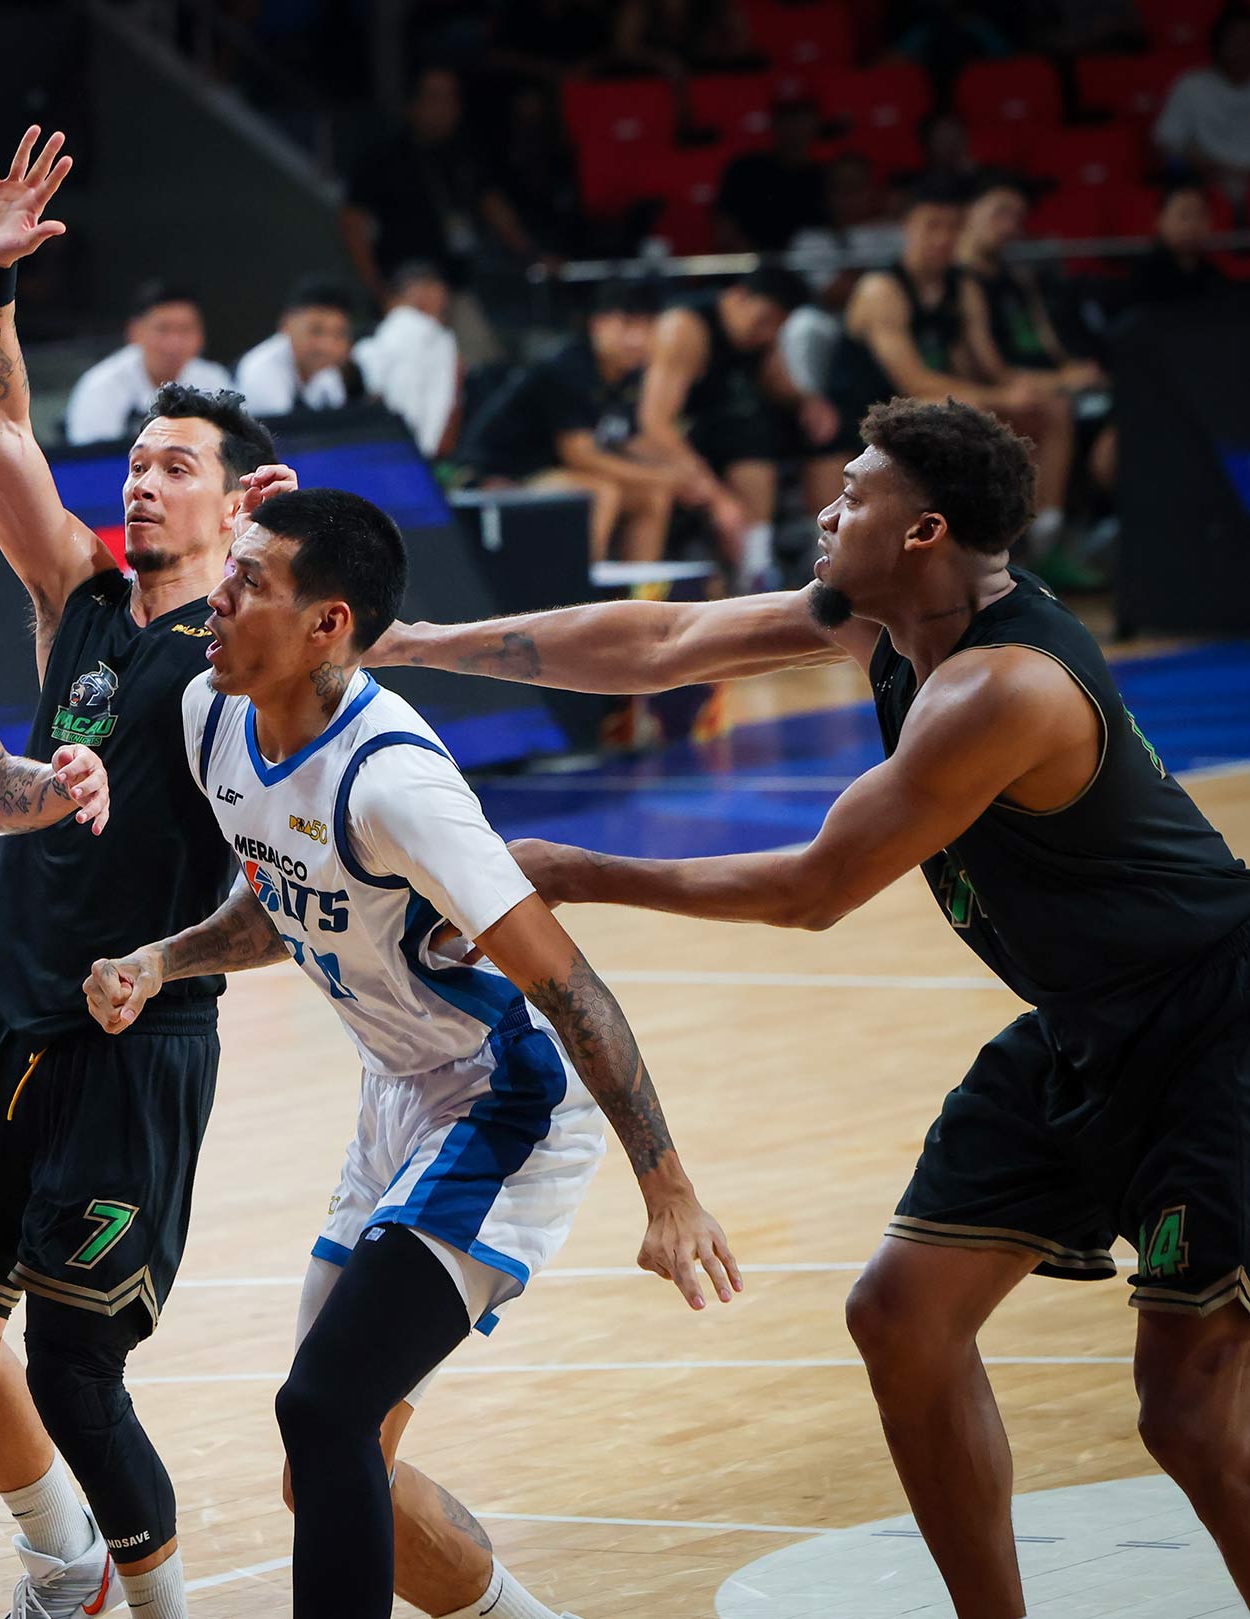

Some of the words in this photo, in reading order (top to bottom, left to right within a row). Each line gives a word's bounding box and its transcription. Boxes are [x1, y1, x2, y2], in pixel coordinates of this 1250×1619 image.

[289, 814, 328, 845] PBA50
[234, 834, 308, 881] MERALCO
[65, 1199, 140, 1270] 7
